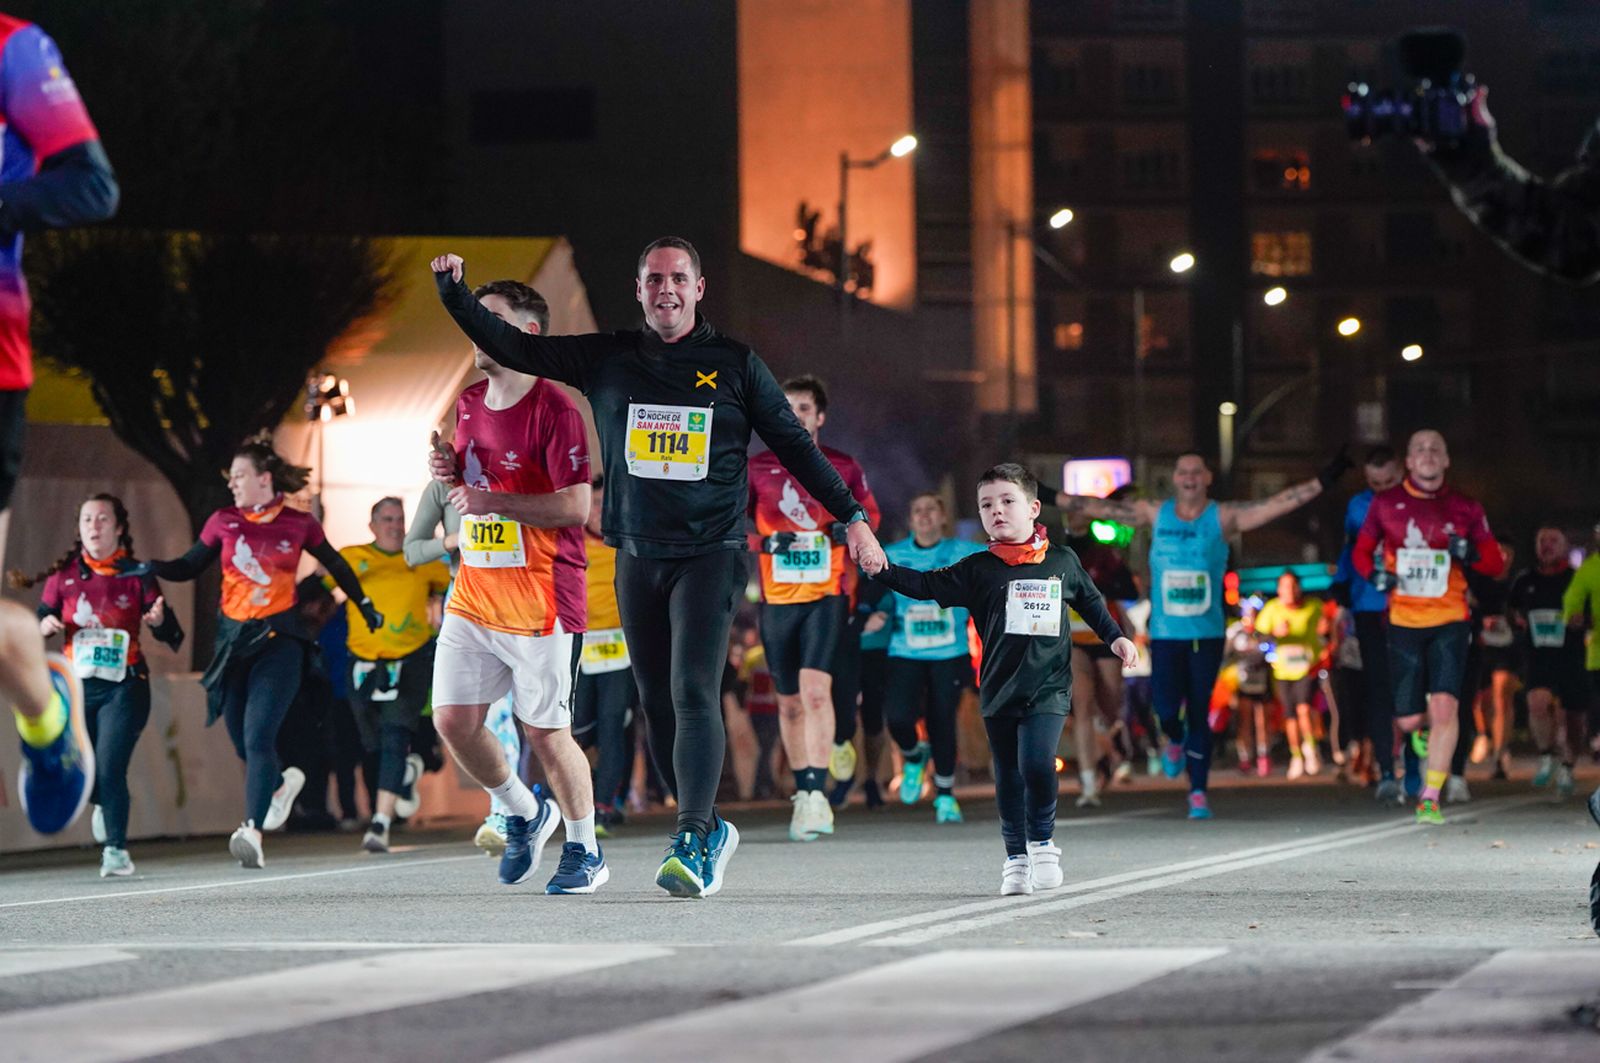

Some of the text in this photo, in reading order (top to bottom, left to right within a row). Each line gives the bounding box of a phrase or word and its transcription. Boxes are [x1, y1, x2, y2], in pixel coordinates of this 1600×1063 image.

[647, 413, 671, 421] NOCHE
[672, 413, 682, 422] DE
[637, 421, 654, 430] SAN
[647, 431, 689, 455] 1114
[471, 522, 505, 544] 4712
[783, 550, 820, 565] 3633
[1023, 601, 1051, 611] 26122
